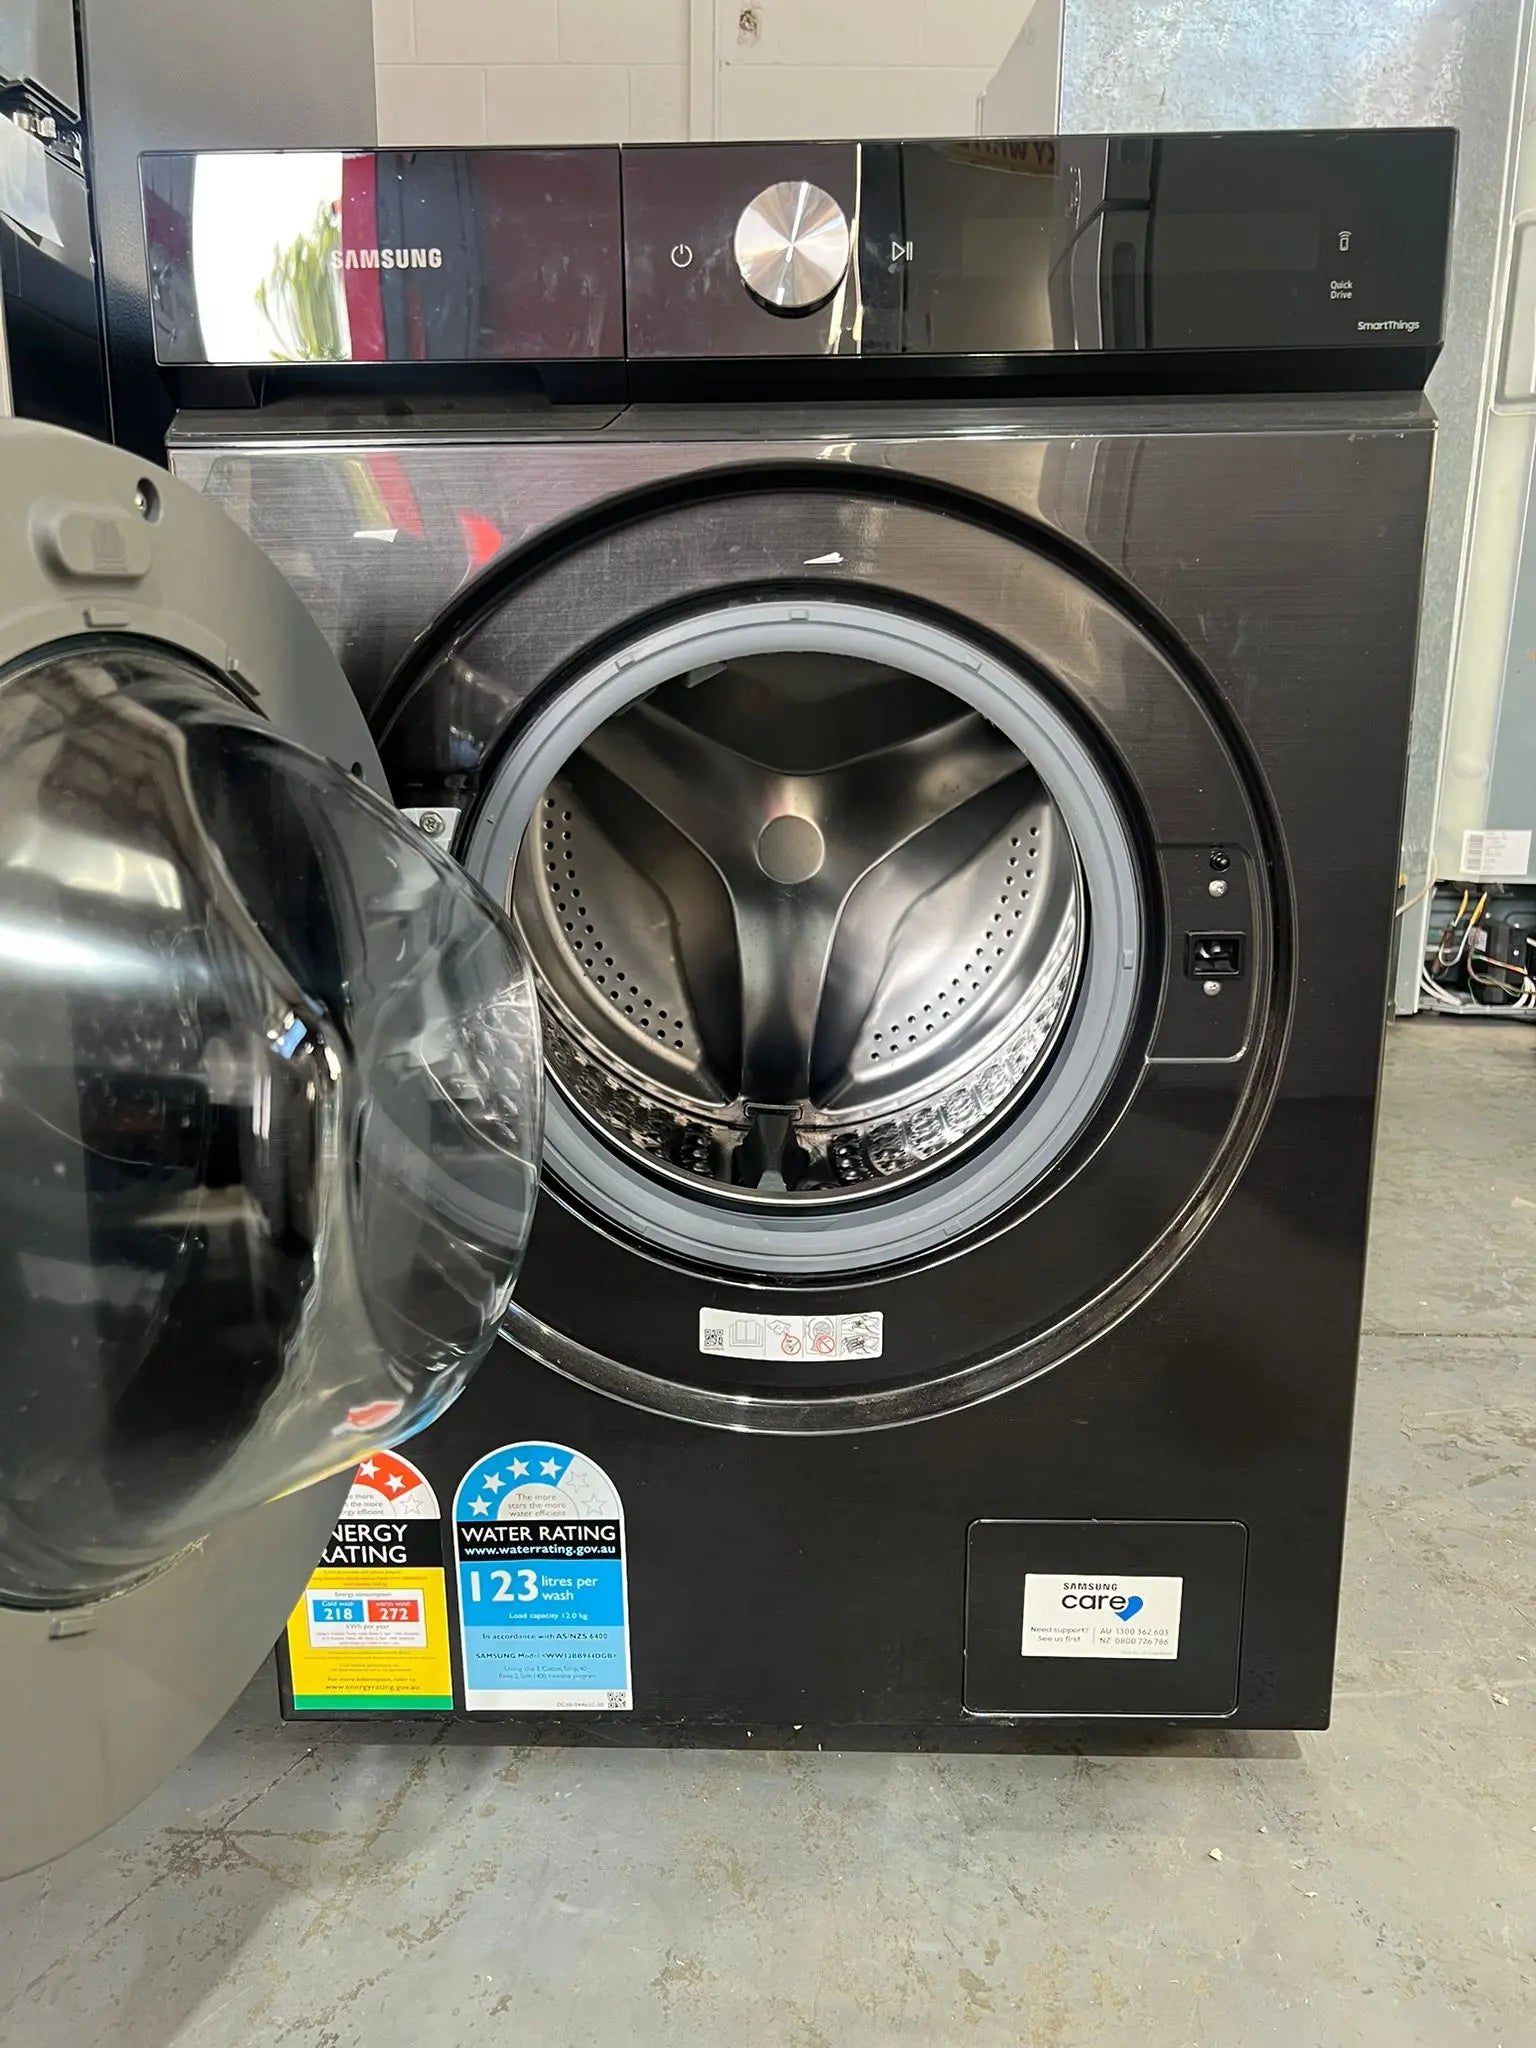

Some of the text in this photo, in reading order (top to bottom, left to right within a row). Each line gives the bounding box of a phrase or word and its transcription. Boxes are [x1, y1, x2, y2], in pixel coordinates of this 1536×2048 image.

[331, 248, 442, 270] SAMSUNG
[1330, 280, 1353, 290] Quick
[1330, 290, 1352, 299] Drive
[1357, 320, 1420, 332] SmartThings
[535, 1509, 566, 1517] efficient
[332, 1524, 408, 1542] NERGY
[461, 1525, 616, 1542] WATER RATING
[464, 1544, 616, 1557] www.waterrating.gov.au
[470, 1569, 539, 1602] 123
[541, 1575, 598, 1590] litres per
[1063, 1582, 1118, 1592] SAMSUNG
[541, 1589, 574, 1601] wash
[1061, 1594, 1127, 1610] care
[324, 1608, 353, 1620] 218
[380, 1608, 409, 1620] 272
[578, 1612, 588, 1620] kg
[1053, 1627, 1089, 1635] support?
